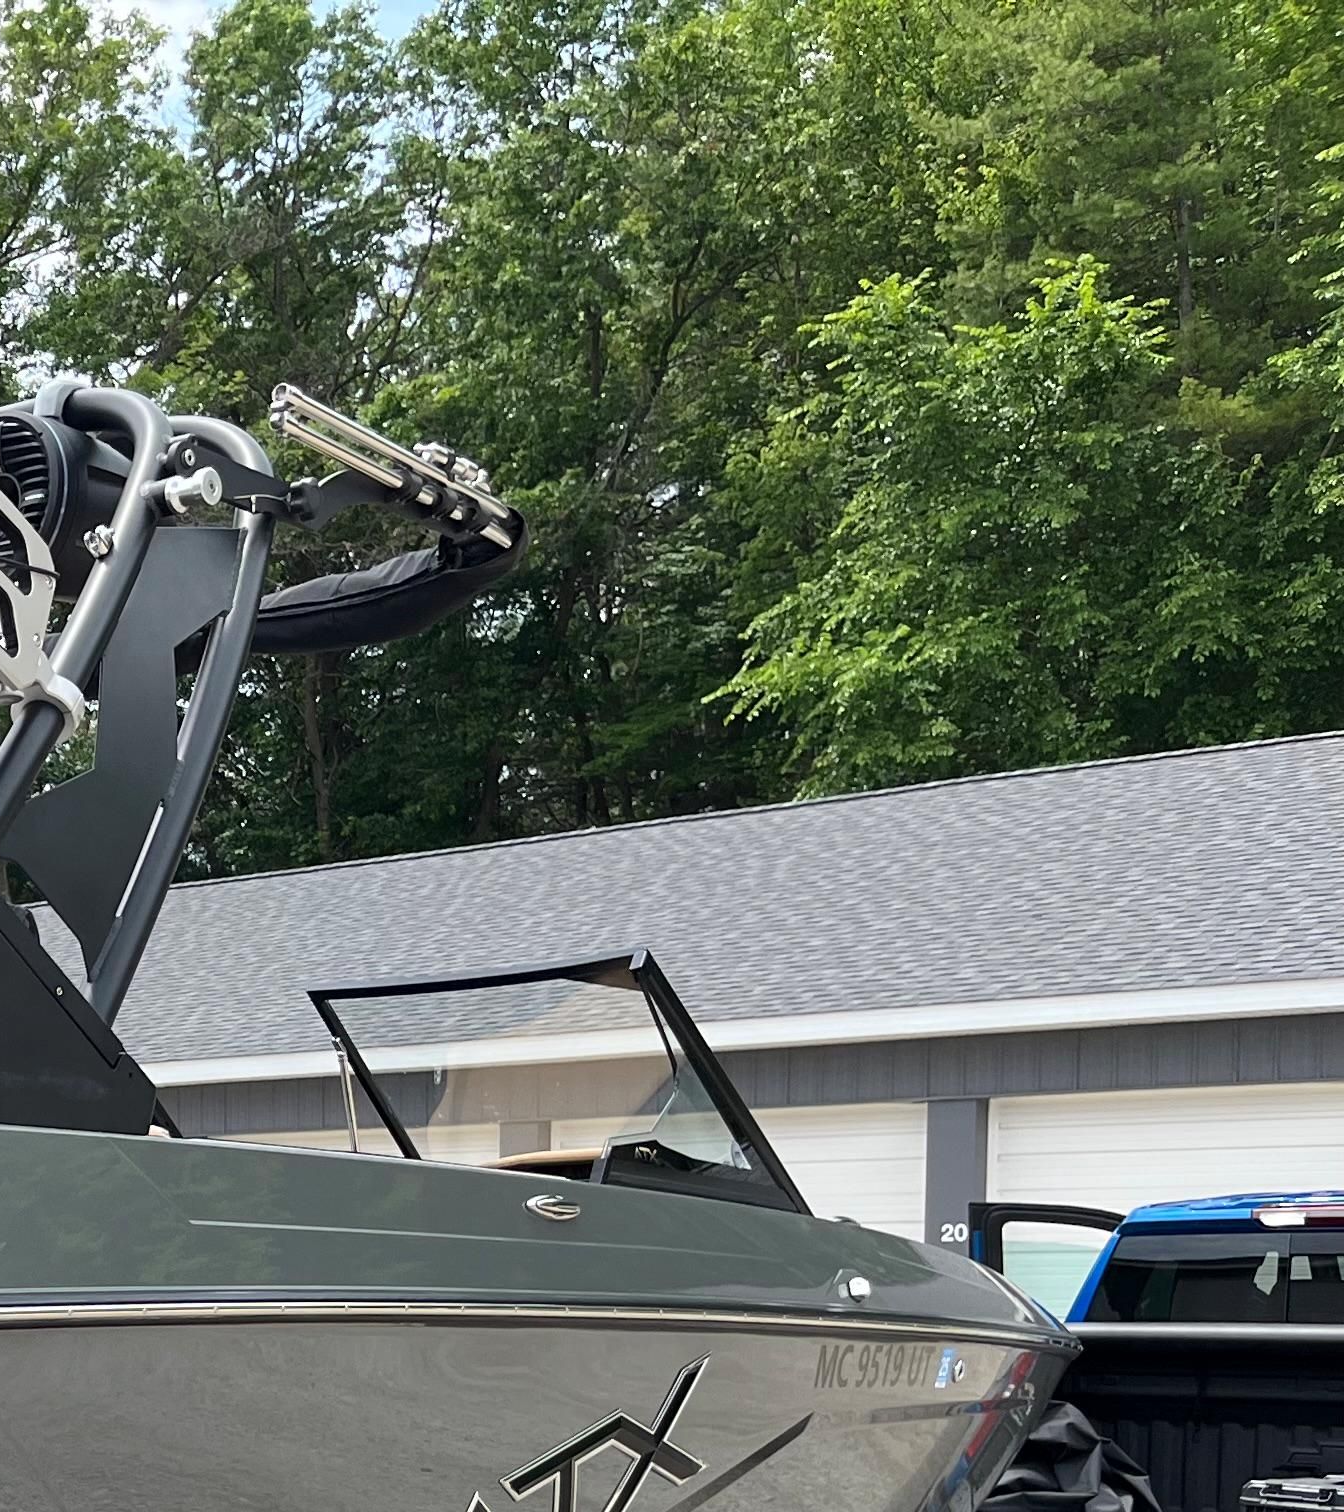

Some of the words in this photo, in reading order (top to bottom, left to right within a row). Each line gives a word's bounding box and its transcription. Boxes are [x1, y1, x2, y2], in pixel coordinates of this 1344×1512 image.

[940, 1223, 968, 1242] 20
[814, 1343, 855, 1388] MC
[855, 1342, 906, 1388] 9519
[906, 1345, 937, 1387] UT
